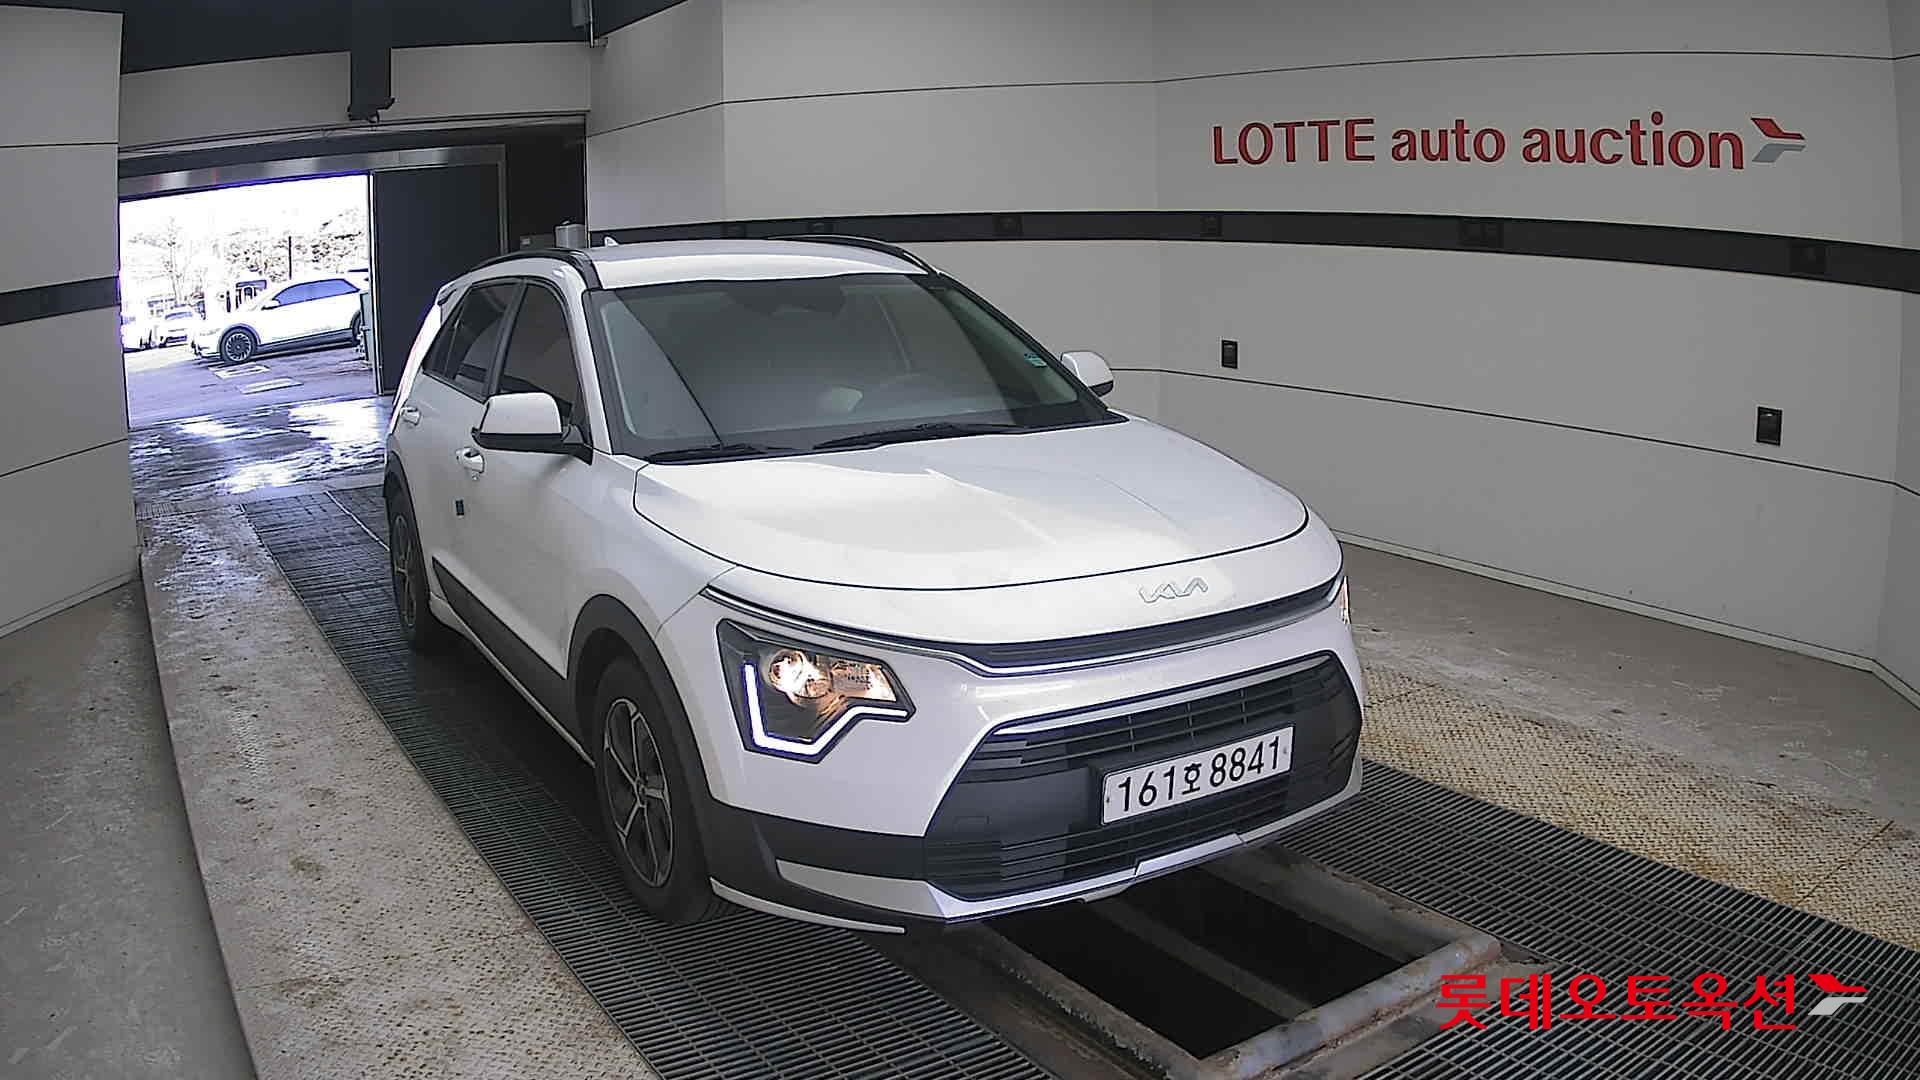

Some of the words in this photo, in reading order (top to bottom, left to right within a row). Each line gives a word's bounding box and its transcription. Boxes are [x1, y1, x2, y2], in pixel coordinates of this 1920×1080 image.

[1213, 119, 1376, 164] LOTTE
[1391, 119, 1506, 162] auto
[1522, 112, 1744, 169] auction
